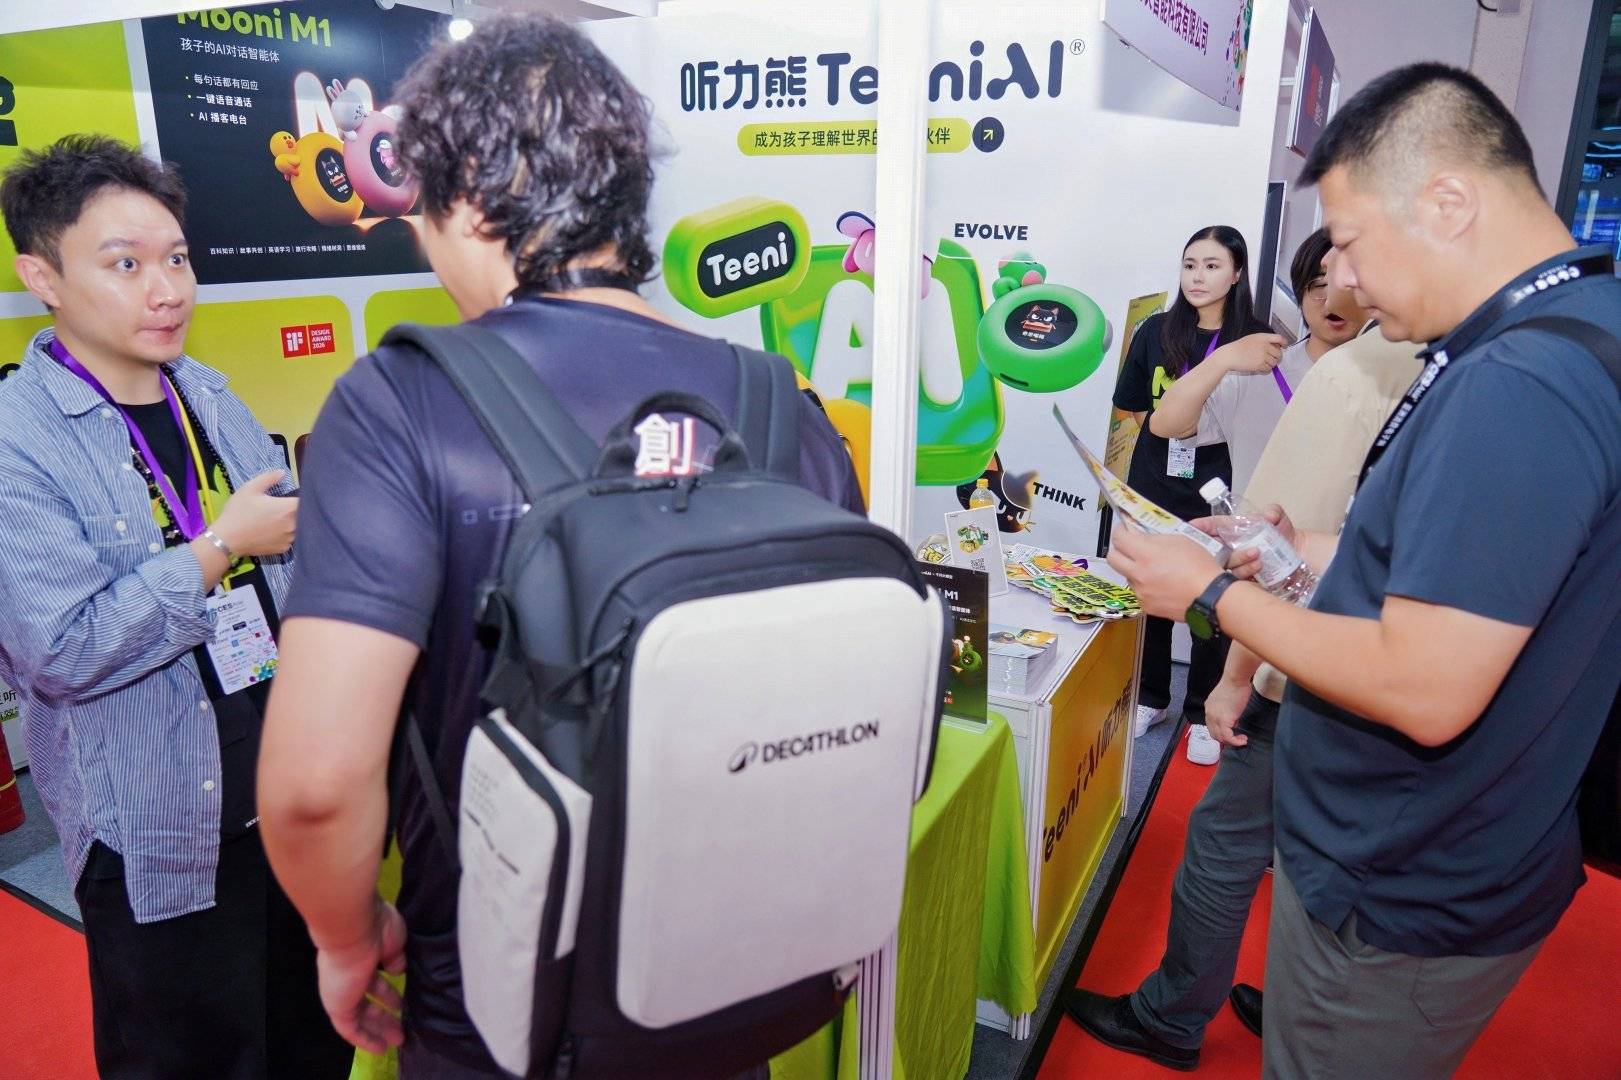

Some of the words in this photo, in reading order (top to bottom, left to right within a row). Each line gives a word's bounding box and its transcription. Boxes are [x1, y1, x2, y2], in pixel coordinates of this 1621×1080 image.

[289, 12, 331, 47] M1
[180, 37, 280, 63] 孩子的AI对话智能体
[194, 73, 259, 91] 每句话都有回应
[680, 56, 807, 112] 听力熊
[817, 40, 1064, 106] TeniAI
[196, 94, 252, 108] 一键语音通话
[198, 112, 208, 122] AI
[210, 113, 247, 125] 播客电台
[954, 222, 1028, 241] EVOLVE
[706, 231, 790, 287] Teeni
[311, 329, 330, 337] DESIGN
[311, 335, 332, 343] AWARD
[634, 413, 694, 477] 創
[1032, 481, 1087, 510] THINK
[944, 590, 959, 601] M1
[763, 718, 879, 763] DECATHLON
